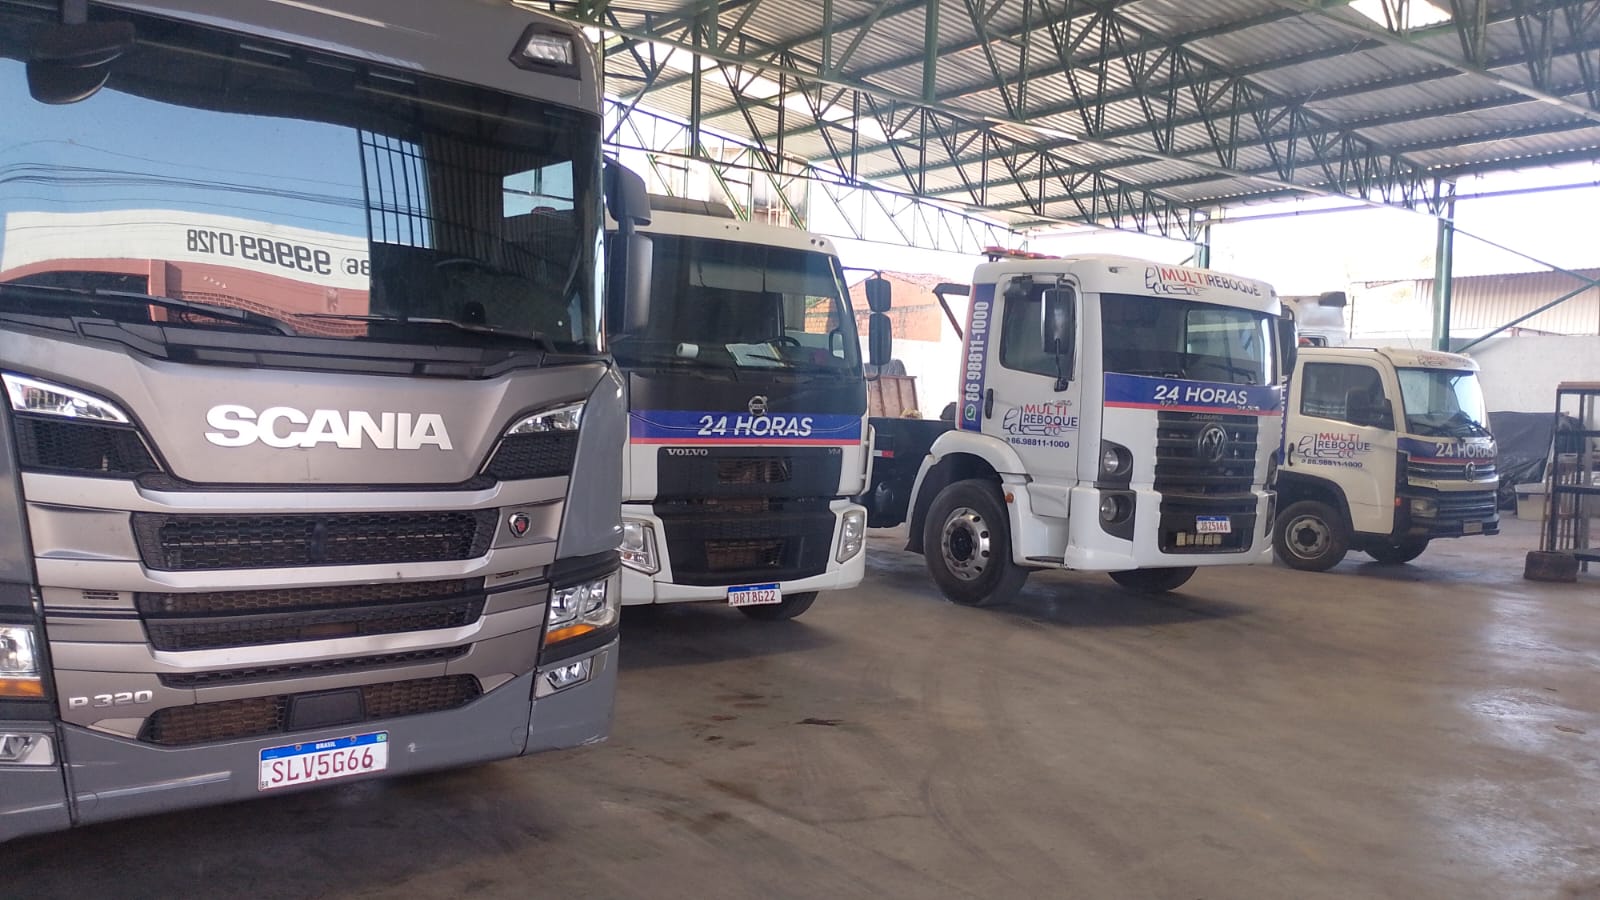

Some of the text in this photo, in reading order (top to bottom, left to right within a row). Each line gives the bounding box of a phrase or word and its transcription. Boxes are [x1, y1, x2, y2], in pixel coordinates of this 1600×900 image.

[965, 301, 989, 401] 86 98811-1000
[1153, 384, 1179, 401] 24
[1185, 387, 1247, 405] HORAS
[1024, 404, 1067, 416] MULTI
[205, 404, 453, 450] SCANIA
[698, 415, 813, 436] 24 HORAS
[1023, 413, 1079, 426] REBOQUE
[1319, 432, 1360, 442] MULTI
[666, 448, 709, 456] VOLVO
[1436, 443, 1453, 457] 24
[68, 690, 153, 710] P 320
[315, 741, 337, 750] BRASIL
[271, 747, 374, 783] SLV5G66
